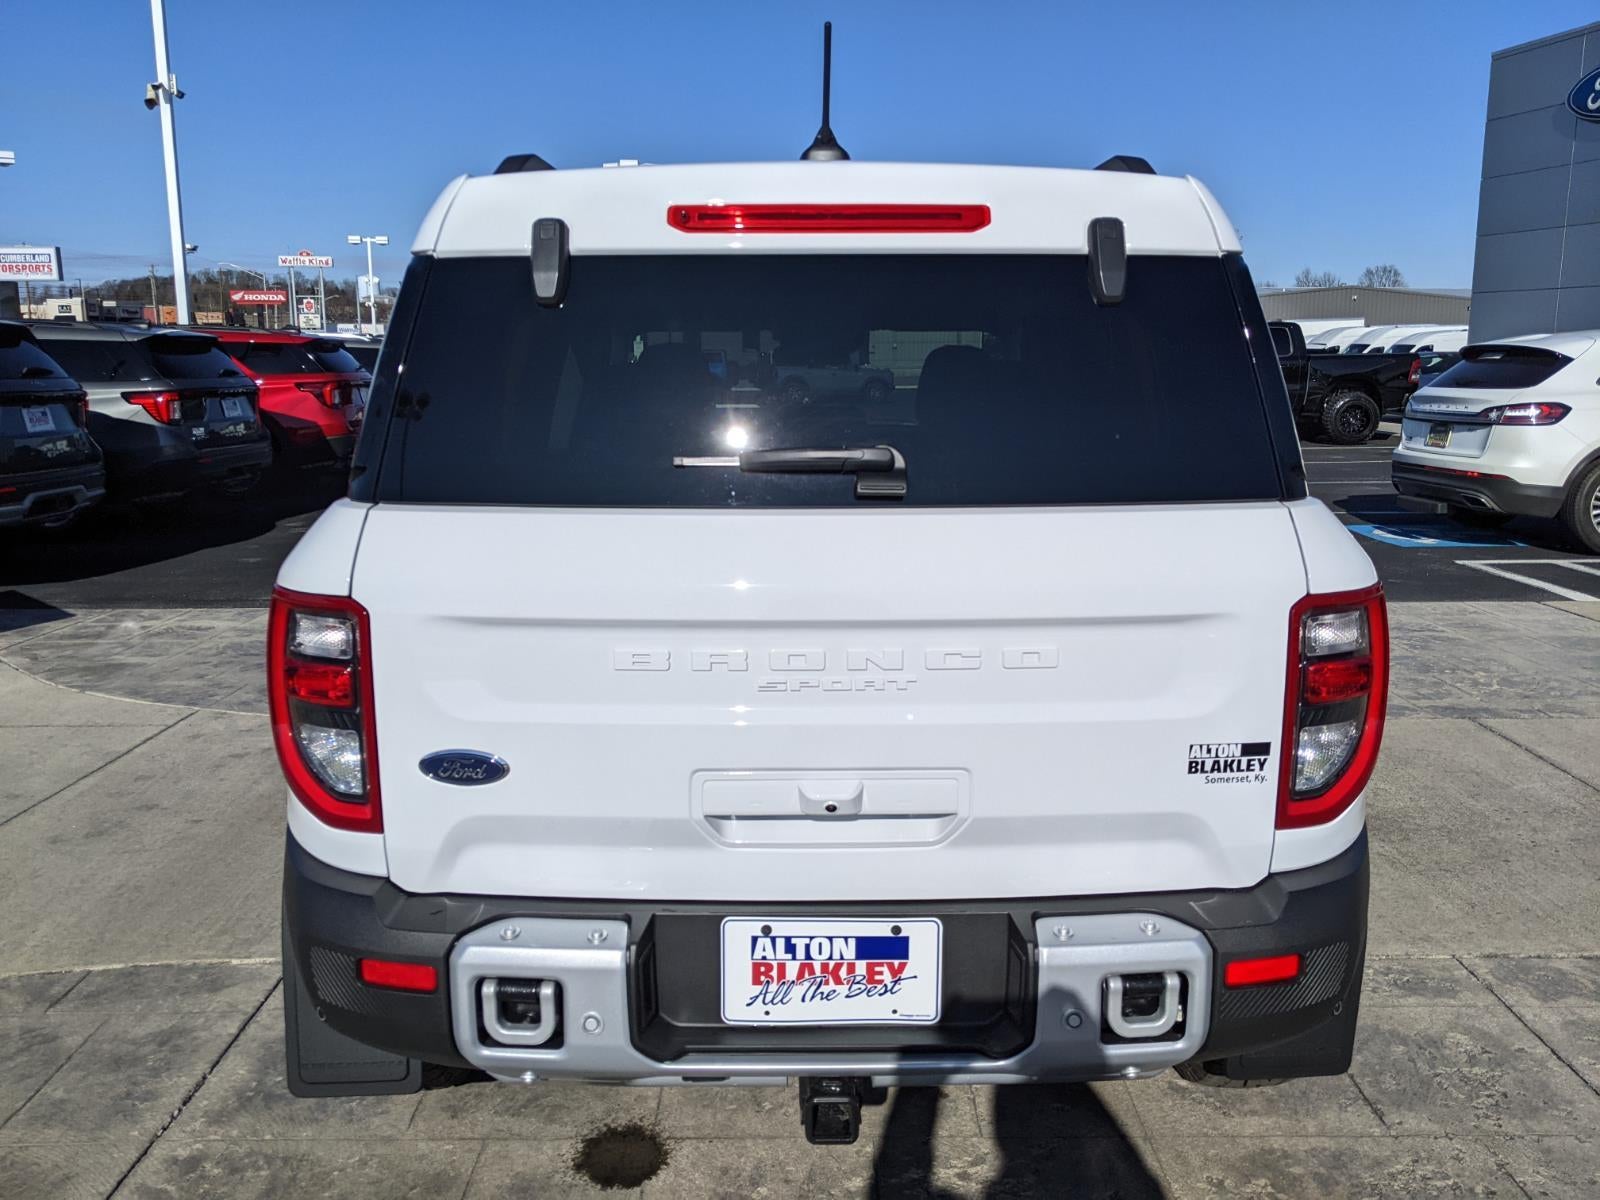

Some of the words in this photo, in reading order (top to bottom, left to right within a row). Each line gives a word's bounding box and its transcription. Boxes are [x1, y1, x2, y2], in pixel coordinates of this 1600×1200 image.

[0, 254, 50, 263] CUMBERLAND
[308, 257, 330, 266] King
[0, 264, 53, 273] ORSPORTS
[613, 647, 1059, 672] BRONCO
[757, 678, 918, 692] SPORT
[1189, 743, 1242, 758] ALTON
[438, 760, 487, 779] Ford
[1187, 757, 1268, 774] BLAKLEY
[1204, 774, 1252, 784] Somerset,
[1254, 773, 1268, 784] Ky.
[752, 937, 857, 960] ALTON
[751, 961, 909, 986] BLAKLEY
[746, 979, 797, 1007] All
[796, 975, 841, 1003] The
[844, 974, 918, 999] Best
